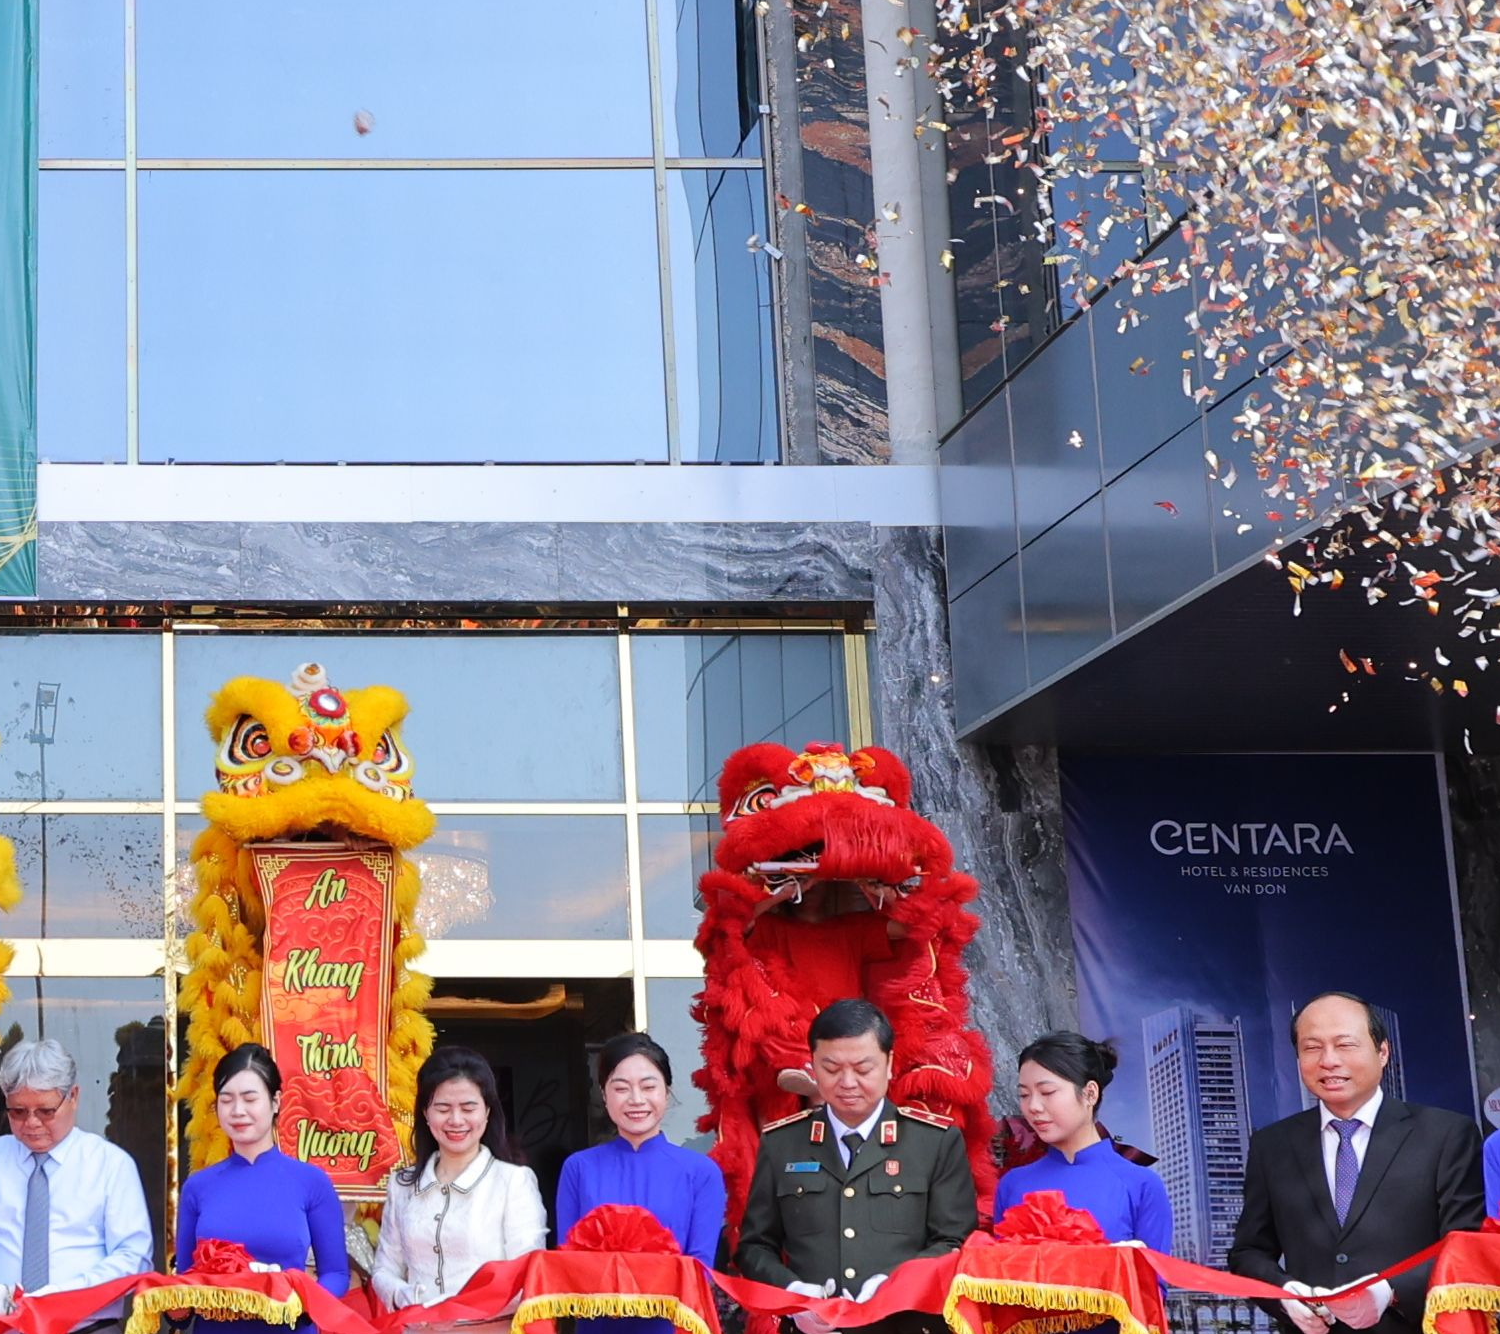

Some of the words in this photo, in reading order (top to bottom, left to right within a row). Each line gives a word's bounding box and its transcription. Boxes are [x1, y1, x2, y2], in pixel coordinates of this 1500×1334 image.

[1149, 819, 1355, 856] CENTARA
[304, 868, 348, 911] An
[1180, 866, 1227, 878] HOTEL
[1230, 866, 1240, 878] &
[1242, 865, 1330, 878] RESIDENCES
[1223, 883, 1251, 895] VAN
[1255, 883, 1287, 895] DON
[283, 948, 365, 1002] Khang
[296, 1031, 362, 1080] Thịnh
[297, 1118, 377, 1172] Vượng
